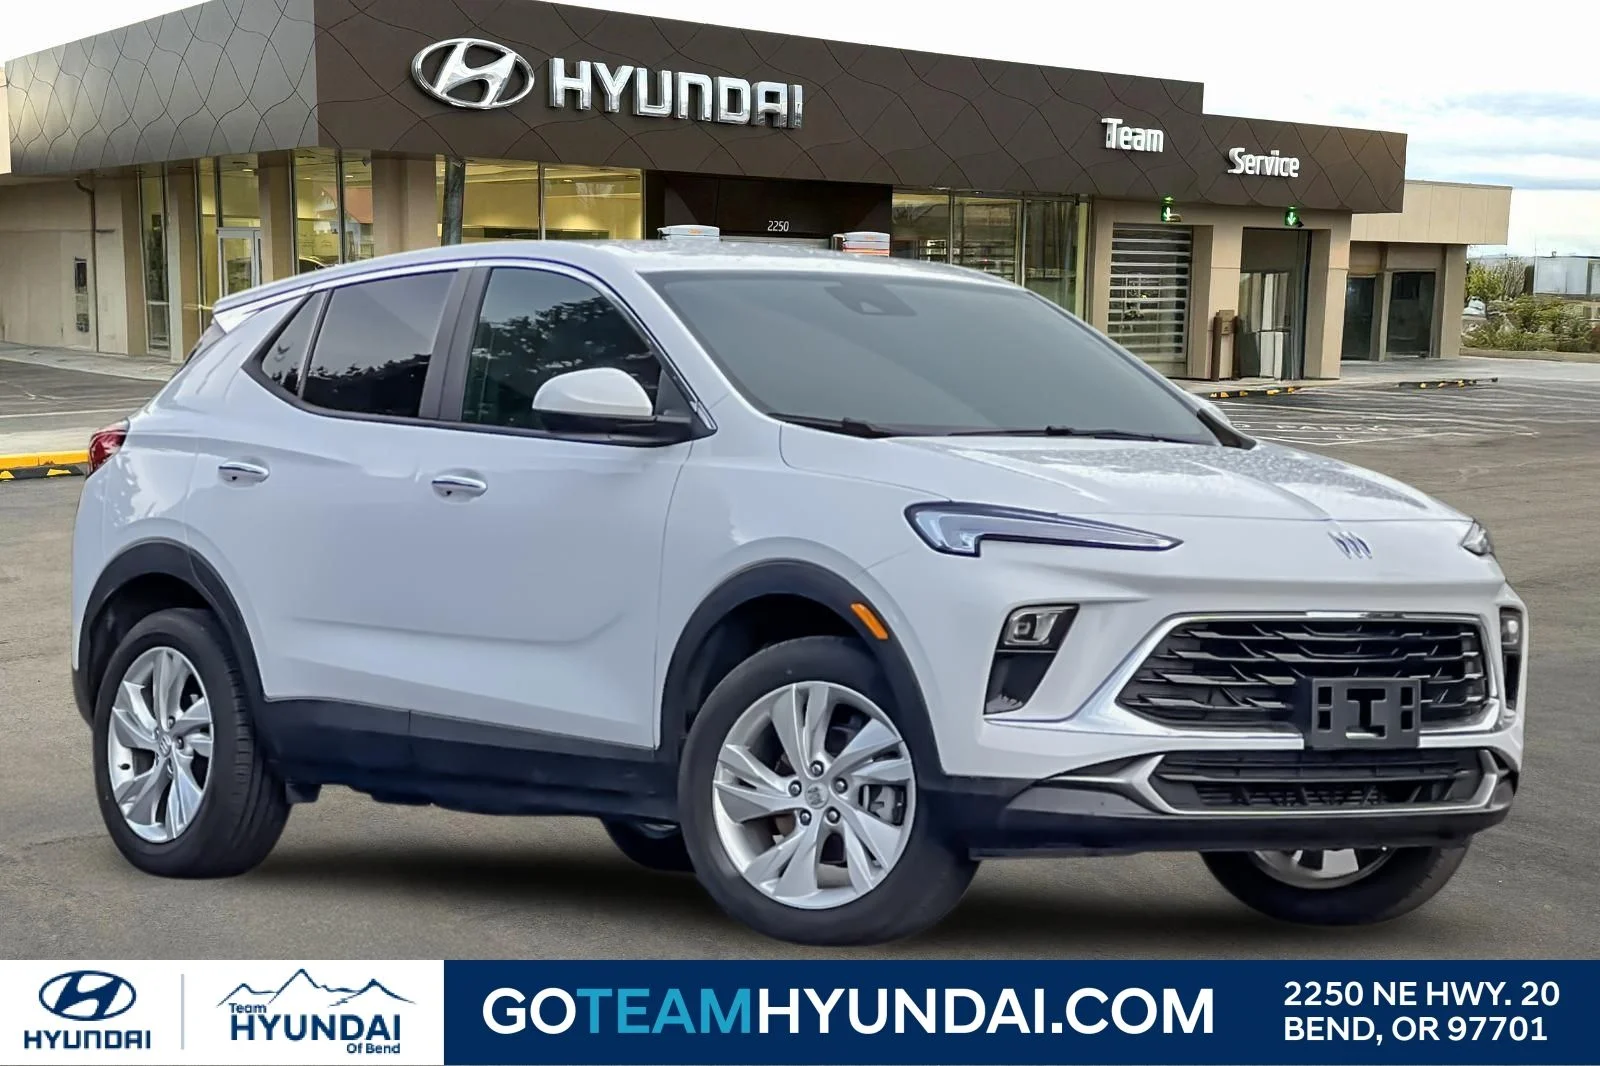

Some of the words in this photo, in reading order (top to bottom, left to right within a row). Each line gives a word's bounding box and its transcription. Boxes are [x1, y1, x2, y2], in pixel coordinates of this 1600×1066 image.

[548, 57, 803, 129] HYUNDAI
[1101, 117, 1164, 153] Team
[1227, 147, 1300, 178] Service
[767, 220, 790, 232] 2250
